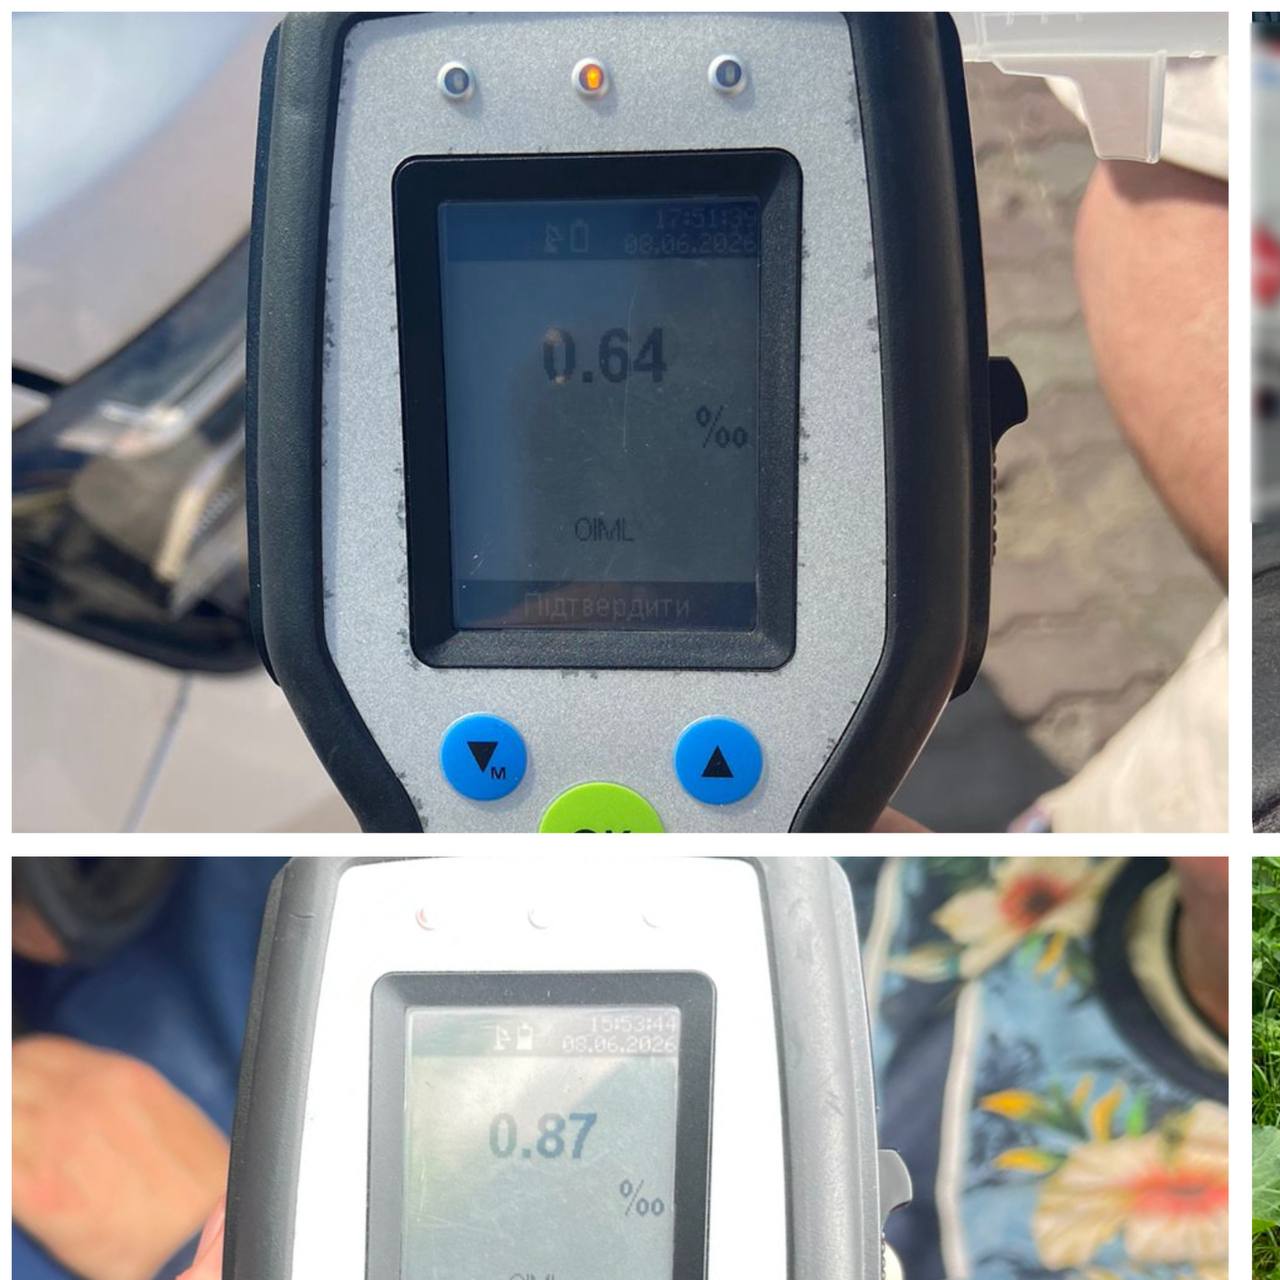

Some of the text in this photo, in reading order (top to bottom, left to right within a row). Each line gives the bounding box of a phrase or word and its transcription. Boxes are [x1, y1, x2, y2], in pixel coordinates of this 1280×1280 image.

[624, 233, 756, 256] 08.06.2026
[543, 327, 667, 384] 0.64
[574, 517, 635, 542] OIML
[523, 592, 690, 622] Підтвердити
[491, 767, 506, 779] M
[590, 1015, 677, 1034] 15:53:44
[562, 1035, 677, 1053] 08.06.2026
[489, 1112, 598, 1160] 0.87
